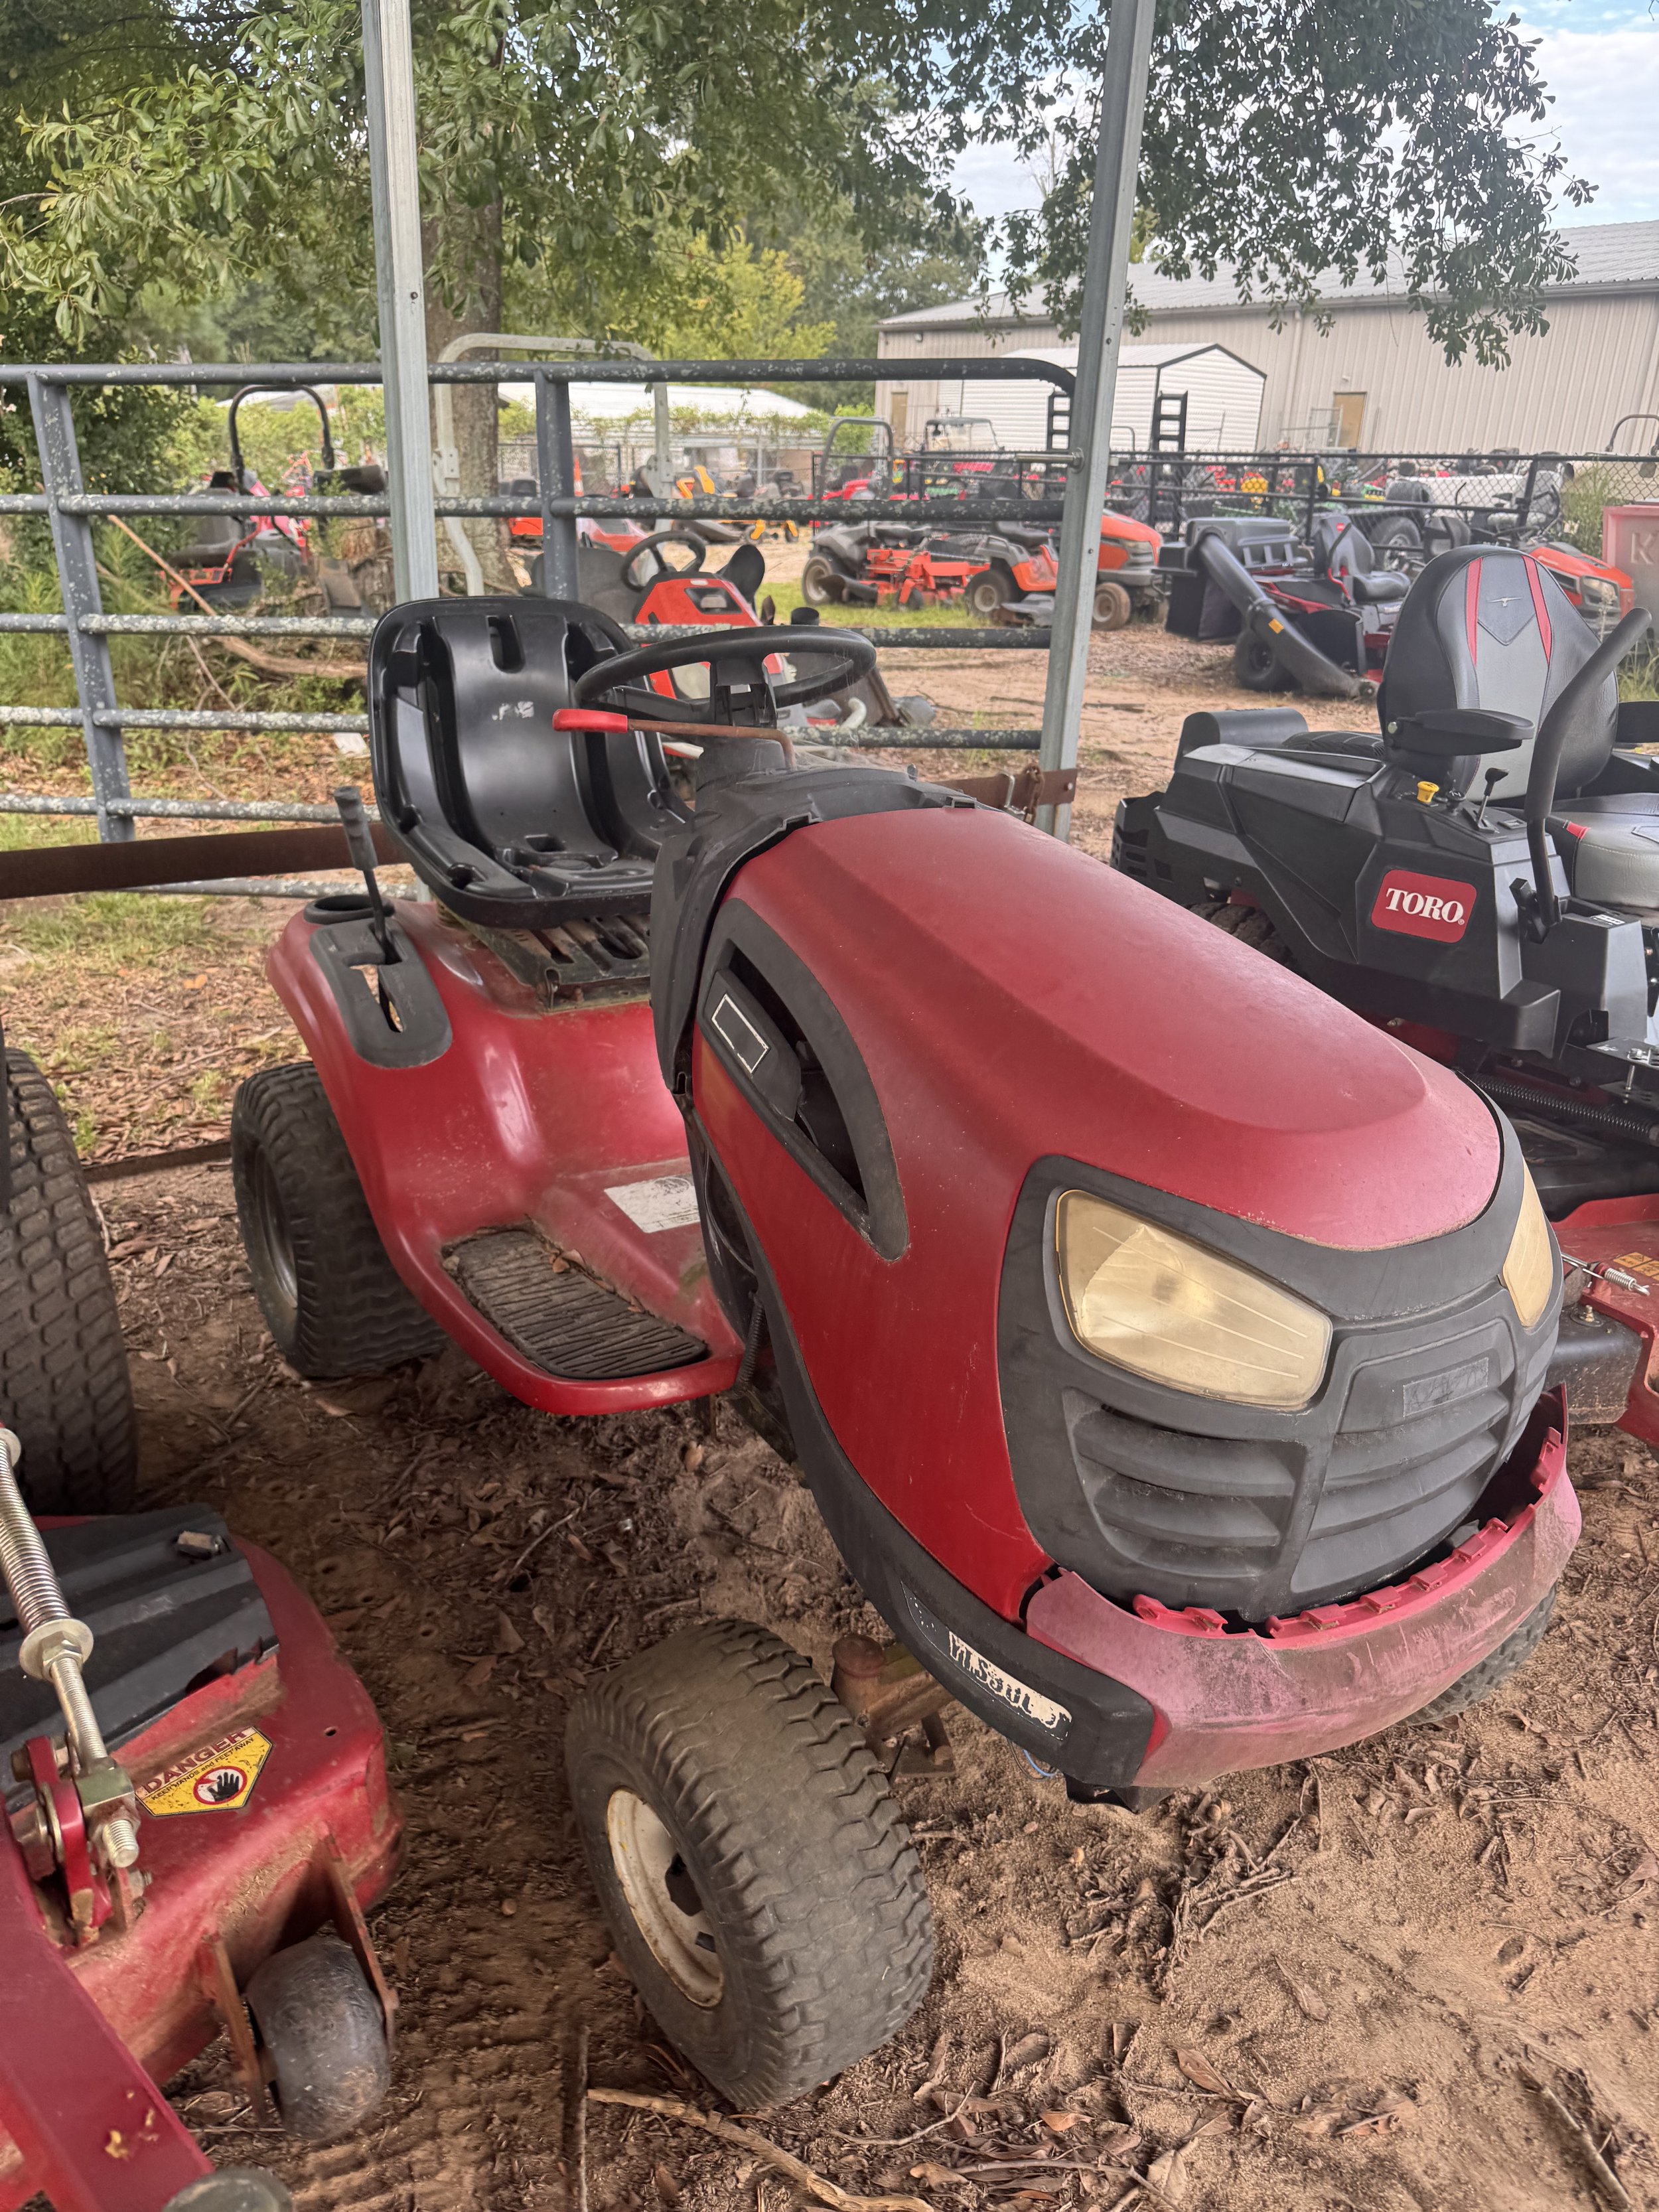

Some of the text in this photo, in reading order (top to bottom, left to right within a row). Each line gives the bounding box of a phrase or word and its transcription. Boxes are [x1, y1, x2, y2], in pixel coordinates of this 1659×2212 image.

[1385, 888, 1464, 924] TORO
[144, 1731, 246, 1794] DANGER
[151, 1785, 171, 1800] KEEP
[201, 1761, 214, 1771] and
[215, 1747, 234, 1763] FEET
[234, 1736, 254, 1751] AWAY
